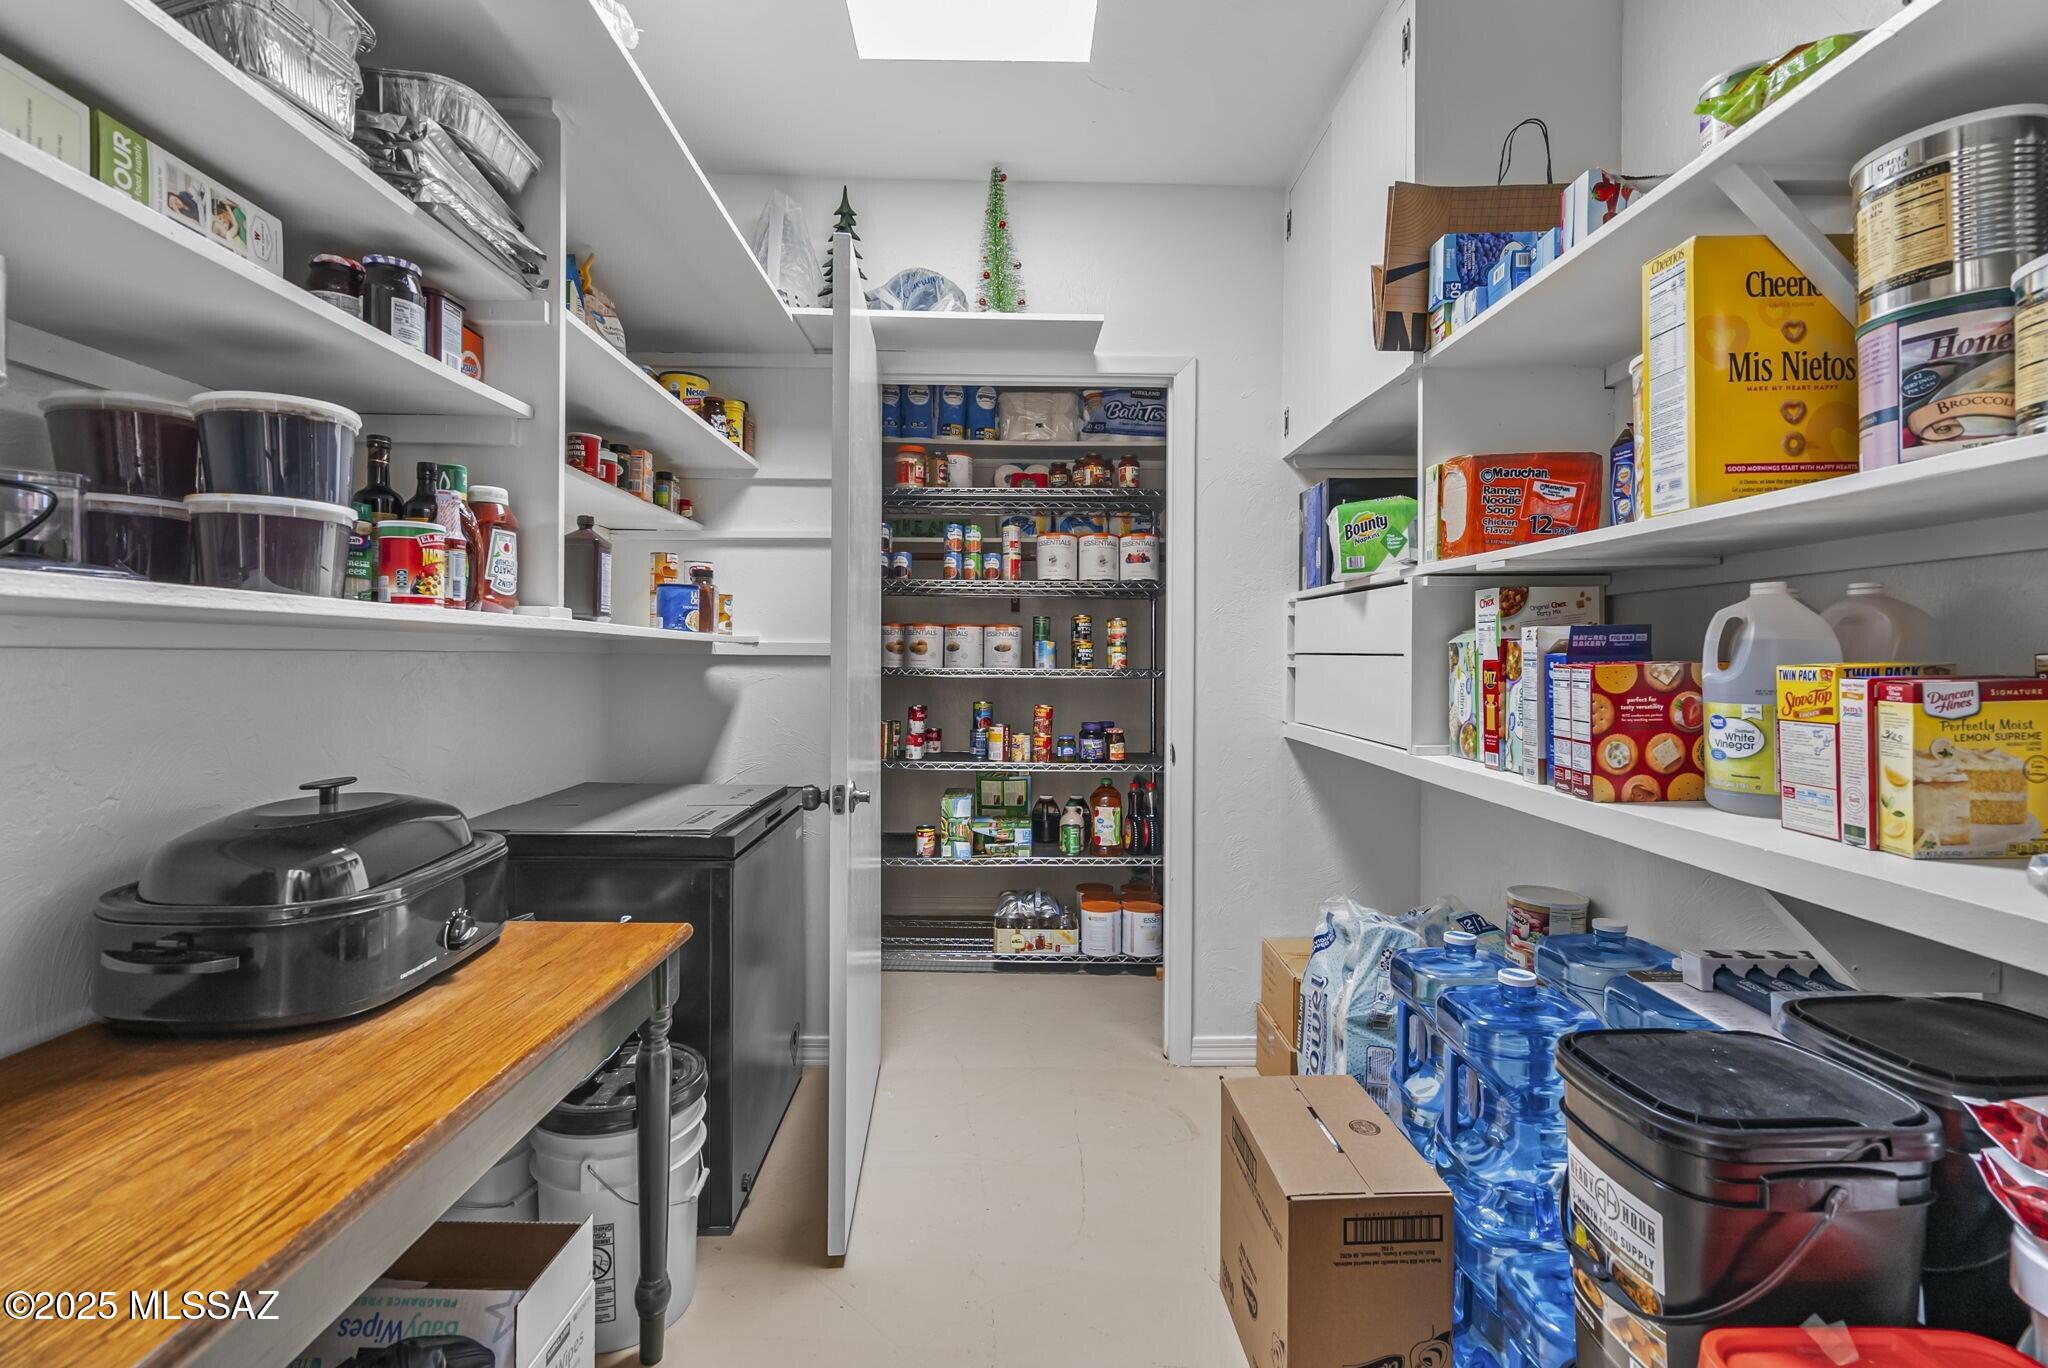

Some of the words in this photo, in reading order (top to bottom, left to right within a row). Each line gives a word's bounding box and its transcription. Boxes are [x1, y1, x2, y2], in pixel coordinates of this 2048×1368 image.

[112, 130, 133, 193] OUR
[133, 143, 143, 173] supply
[1651, 248, 1685, 275] Cheerios
[1450, 282, 1462, 299] 50
[1728, 351, 1773, 383] Mis
[1782, 351, 1857, 382] Nietos
[1912, 372, 1923, 380] 42
[1105, 399, 1143, 420] Bath
[1937, 395, 2014, 415] BROCCOLI
[1483, 485, 1521, 495] Ramen
[1482, 495, 1522, 505] Noodle
[1486, 505, 1515, 516] Soup
[1344, 515, 1388, 541] Bounty
[1482, 517, 1518, 527] Chicken
[1529, 514, 1554, 535] 12
[1553, 526, 1577, 535] PACK
[1484, 526, 1513, 535] Flavor
[1354, 533, 1380, 546] Napkins
[347, 569, 367, 577] eese
[1480, 598, 1495, 609] Chex
[1530, 603, 1550, 612] Original
[1550, 601, 1568, 609] Chex
[1483, 670, 1497, 685] RITZ
[1778, 669, 1797, 681] TWIN
[1798, 670, 1818, 682] PACK
[1843, 668, 1881, 678] TWIN
[1885, 666, 1921, 677] PACK
[1927, 689, 1975, 705] Duncan
[1990, 688, 2043, 696] SIGNATURE
[1626, 696, 1648, 705] perfect
[1934, 699, 1973, 714] Hines
[1620, 704, 1635, 712] tasty
[1636, 703, 1664, 711] versatility
[1842, 705, 1863, 714] Betty's
[1939, 718, 1995, 732] Perfectly
[2000, 718, 2034, 730] Moist
[1724, 732, 1756, 743] White
[1953, 733, 1991, 743] LEMON
[1994, 731, 2043, 741] SUPREME
[1715, 739, 1755, 752] Vinegar
[1297, 995, 1305, 1049] KIRKLAND
[1306, 974, 1329, 1076] owel
[1570, 1156, 1594, 1195] READY
[1622, 1207, 1656, 1245] HOUR
[1599, 1217, 1619, 1242] FOOD
[1620, 1235, 1655, 1271] SUPPLY
[385, 1298, 459, 1309] FRAGRANCE
[337, 1311, 403, 1344] Wipes
